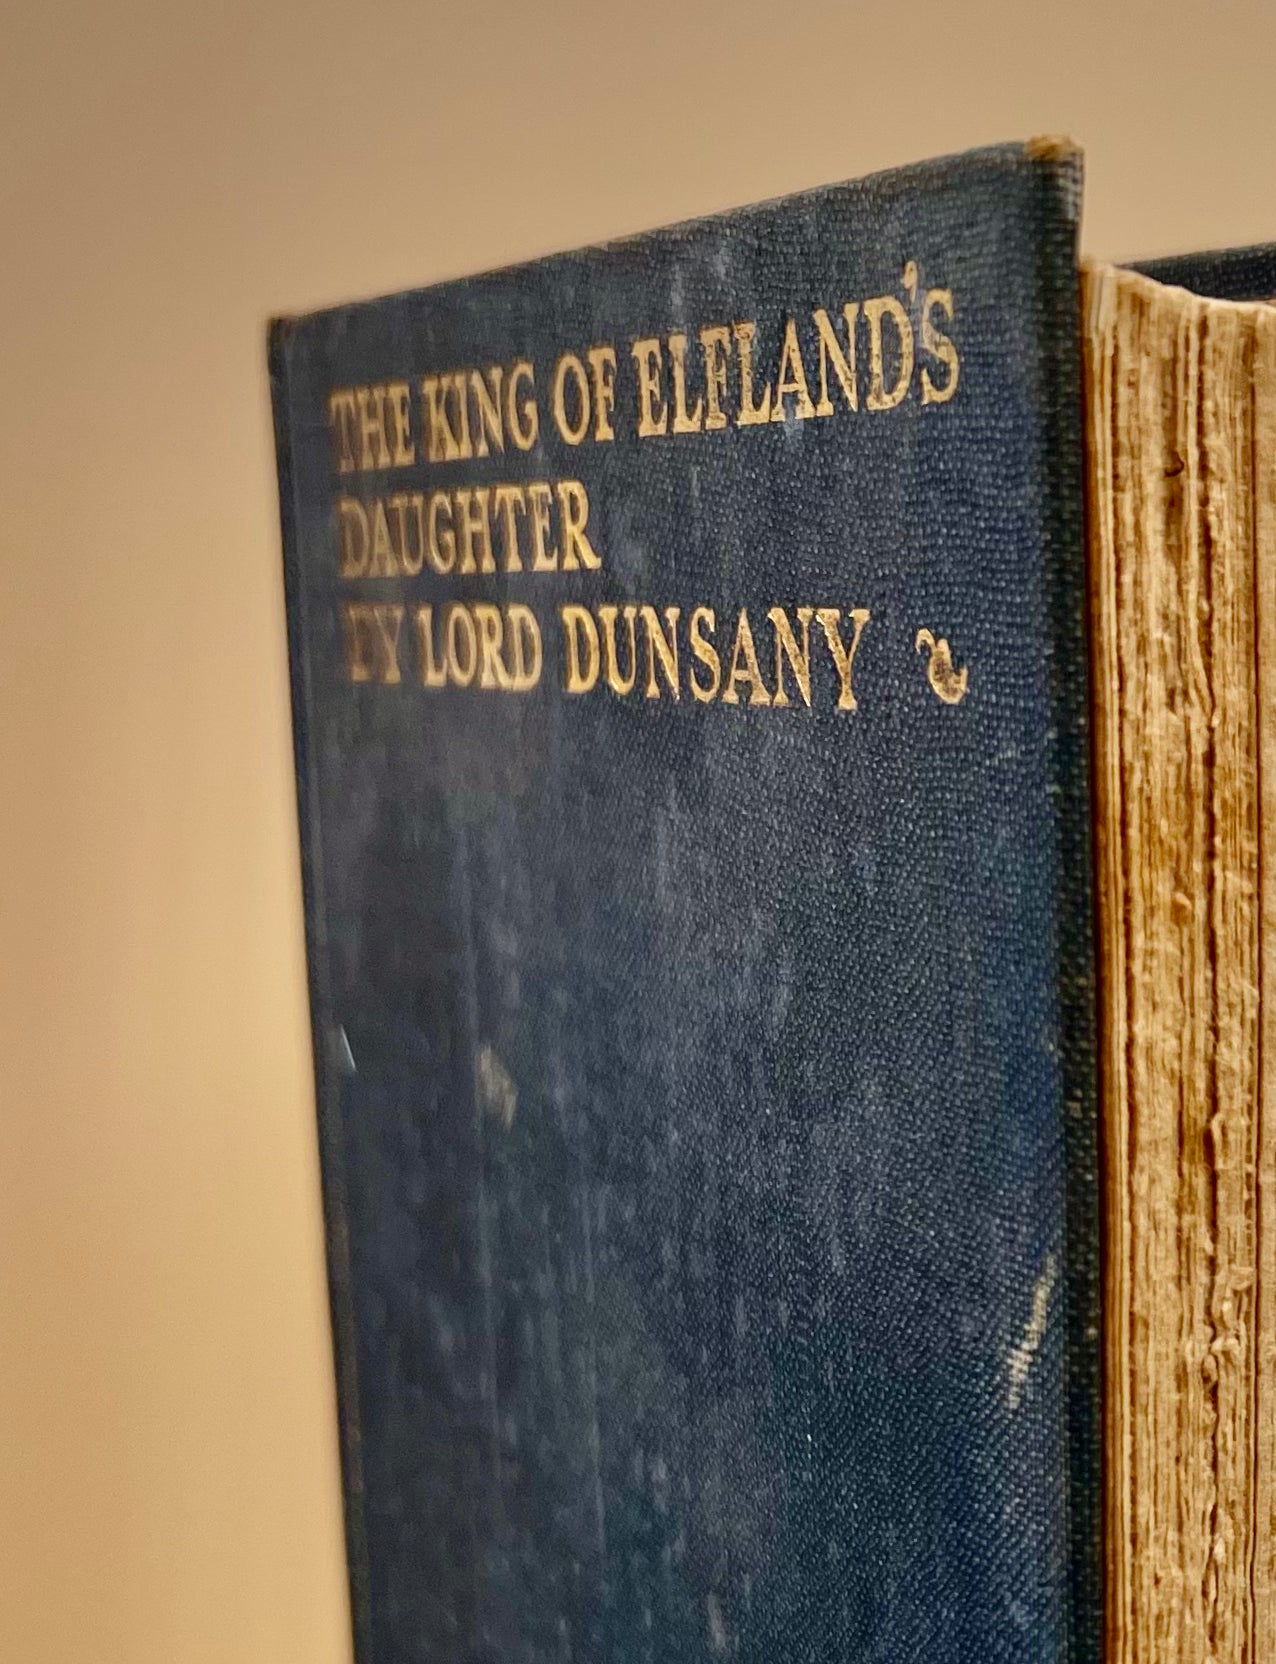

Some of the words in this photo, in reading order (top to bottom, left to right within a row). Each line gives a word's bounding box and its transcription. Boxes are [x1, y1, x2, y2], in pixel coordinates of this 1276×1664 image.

[328, 386, 416, 474] THE
[421, 364, 541, 463] KING
[554, 346, 616, 445] OF
[632, 260, 960, 438] ELFLAND'S
[338, 479, 602, 578] DAUGHTER
[415, 603, 544, 691] LORD
[562, 604, 871, 711] DUNSANY
